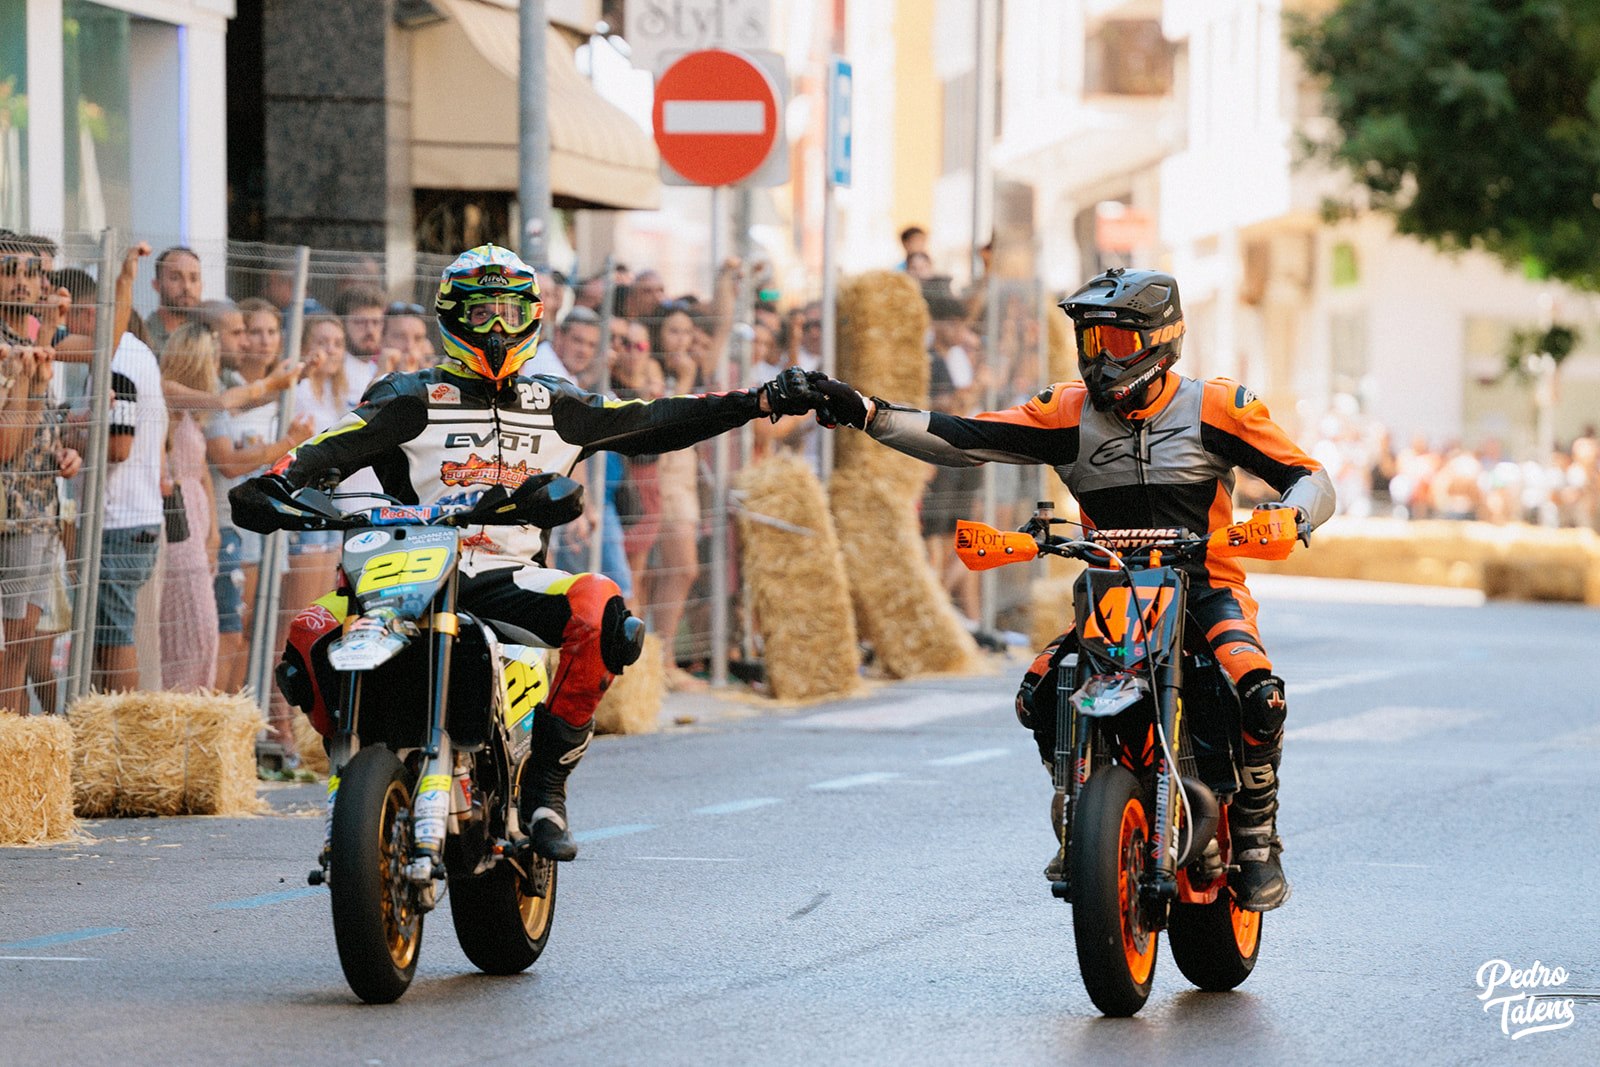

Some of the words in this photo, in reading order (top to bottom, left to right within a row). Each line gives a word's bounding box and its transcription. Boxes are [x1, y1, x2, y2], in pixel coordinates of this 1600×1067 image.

[517, 381, 551, 410] 29
[381, 507, 405, 519] Red
[406, 508, 431, 519] Bull
[974, 529, 1009, 546] Fort
[1092, 528, 1178, 538] RENTHAL
[1249, 522, 1284, 538] Fort
[356, 547, 450, 596] 29
[1082, 586, 1176, 644] 47
